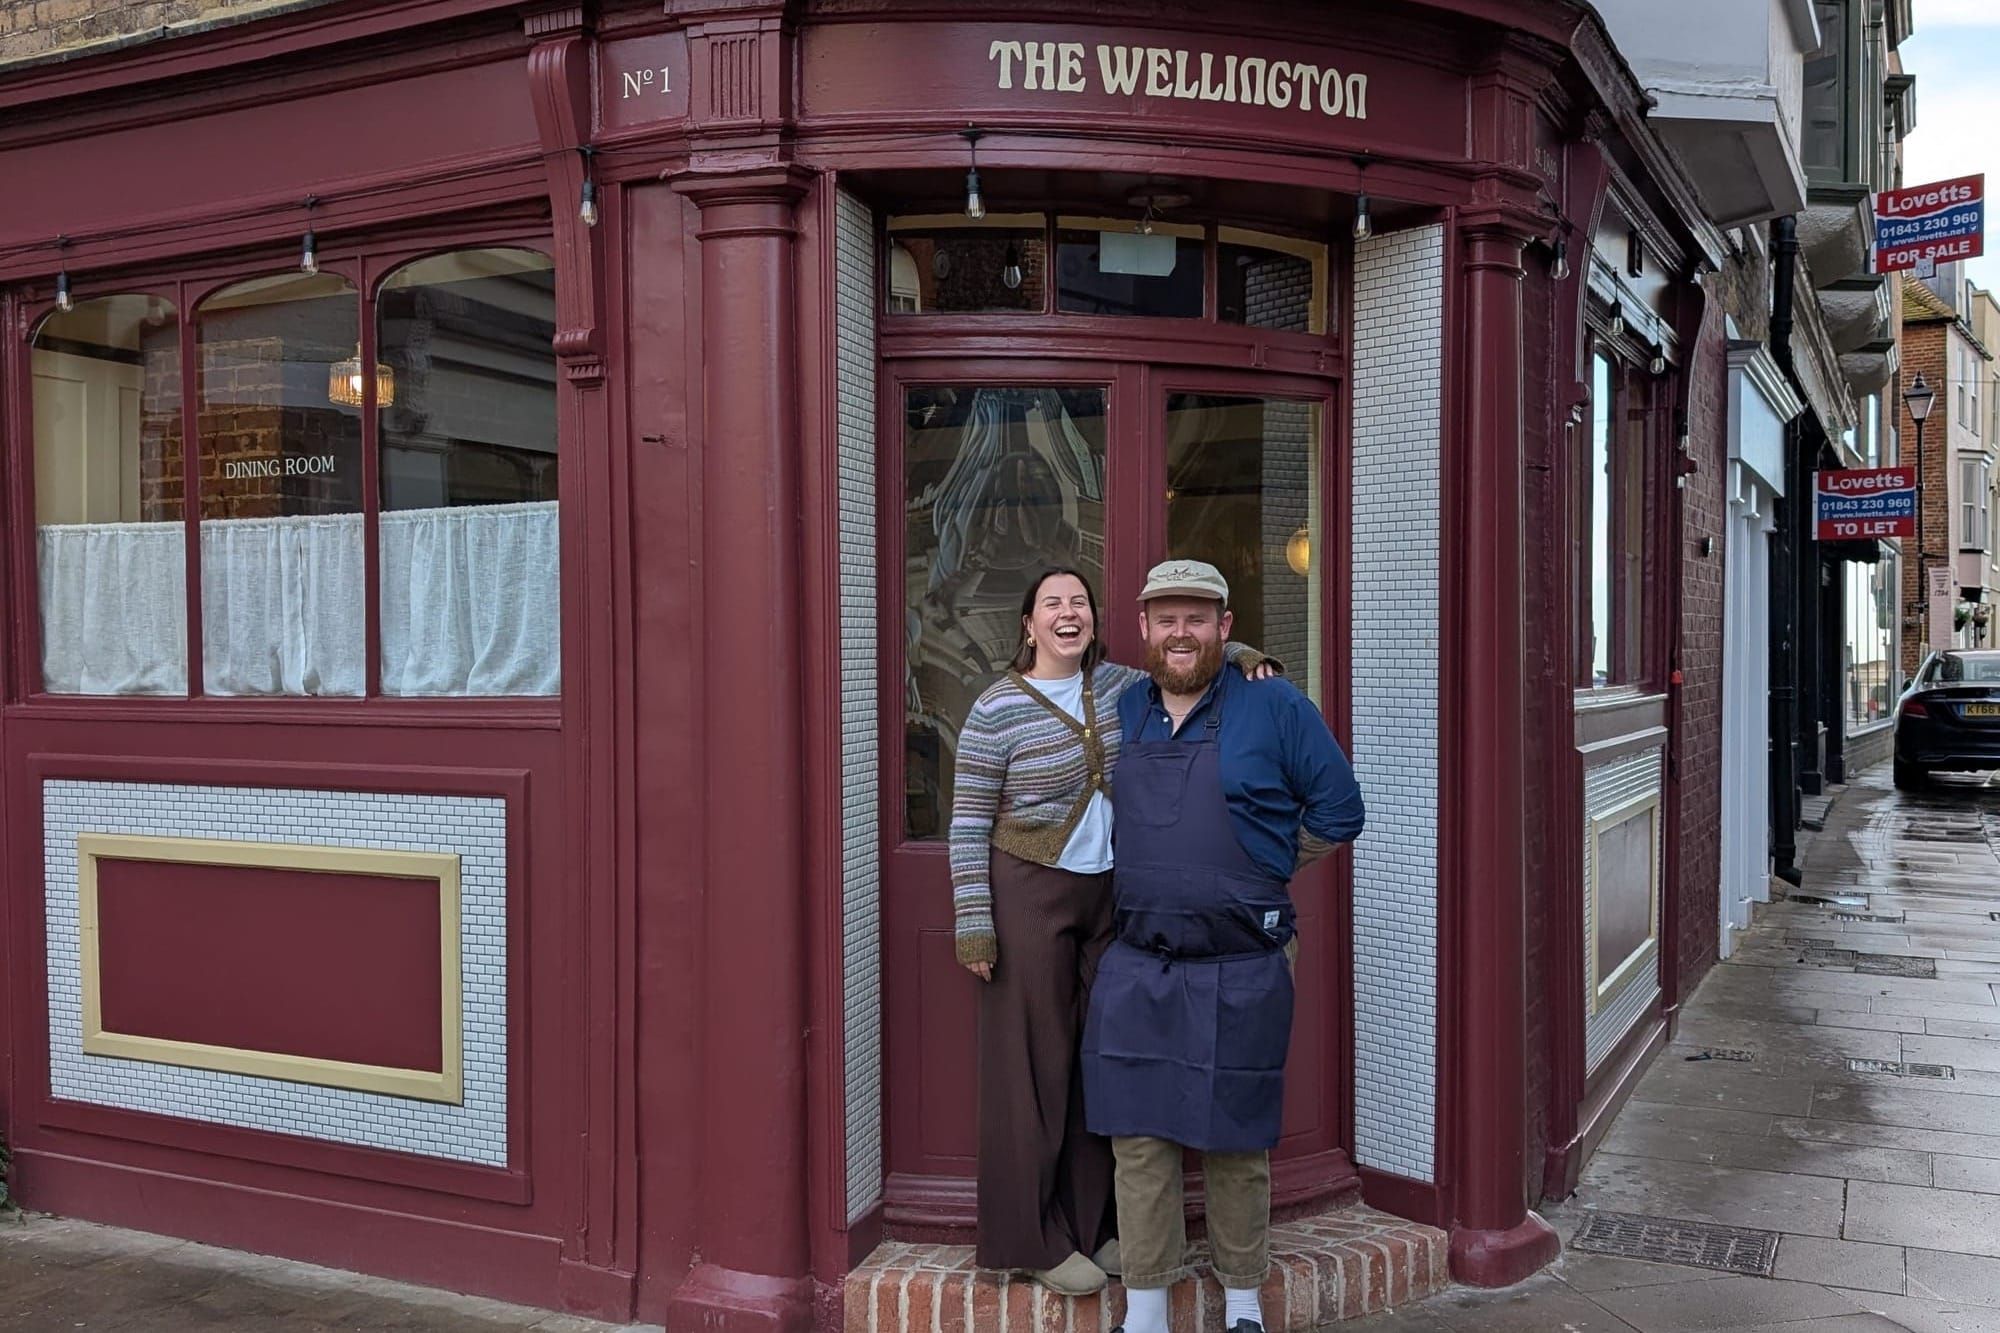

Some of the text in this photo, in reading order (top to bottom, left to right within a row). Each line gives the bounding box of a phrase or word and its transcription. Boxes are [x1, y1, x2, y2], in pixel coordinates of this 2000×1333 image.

[660, 66, 672, 93] 1
[988, 41, 1368, 119] THE WELLINGTON
[1887, 185, 1972, 213] Lovetts
[1880, 211, 1978, 238] 01843 230 960
[1892, 227, 1966, 246] www.lovetts.net
[1887, 240, 1971, 266] FOR SALE
[225, 455, 335, 479] DINING ROOM
[1827, 473, 1905, 491] Lovetts
[1821, 498, 1911, 511] 01843 230 960
[1832, 510, 1900, 519] www.lovetts.net
[1833, 521, 1898, 536] TO LET
